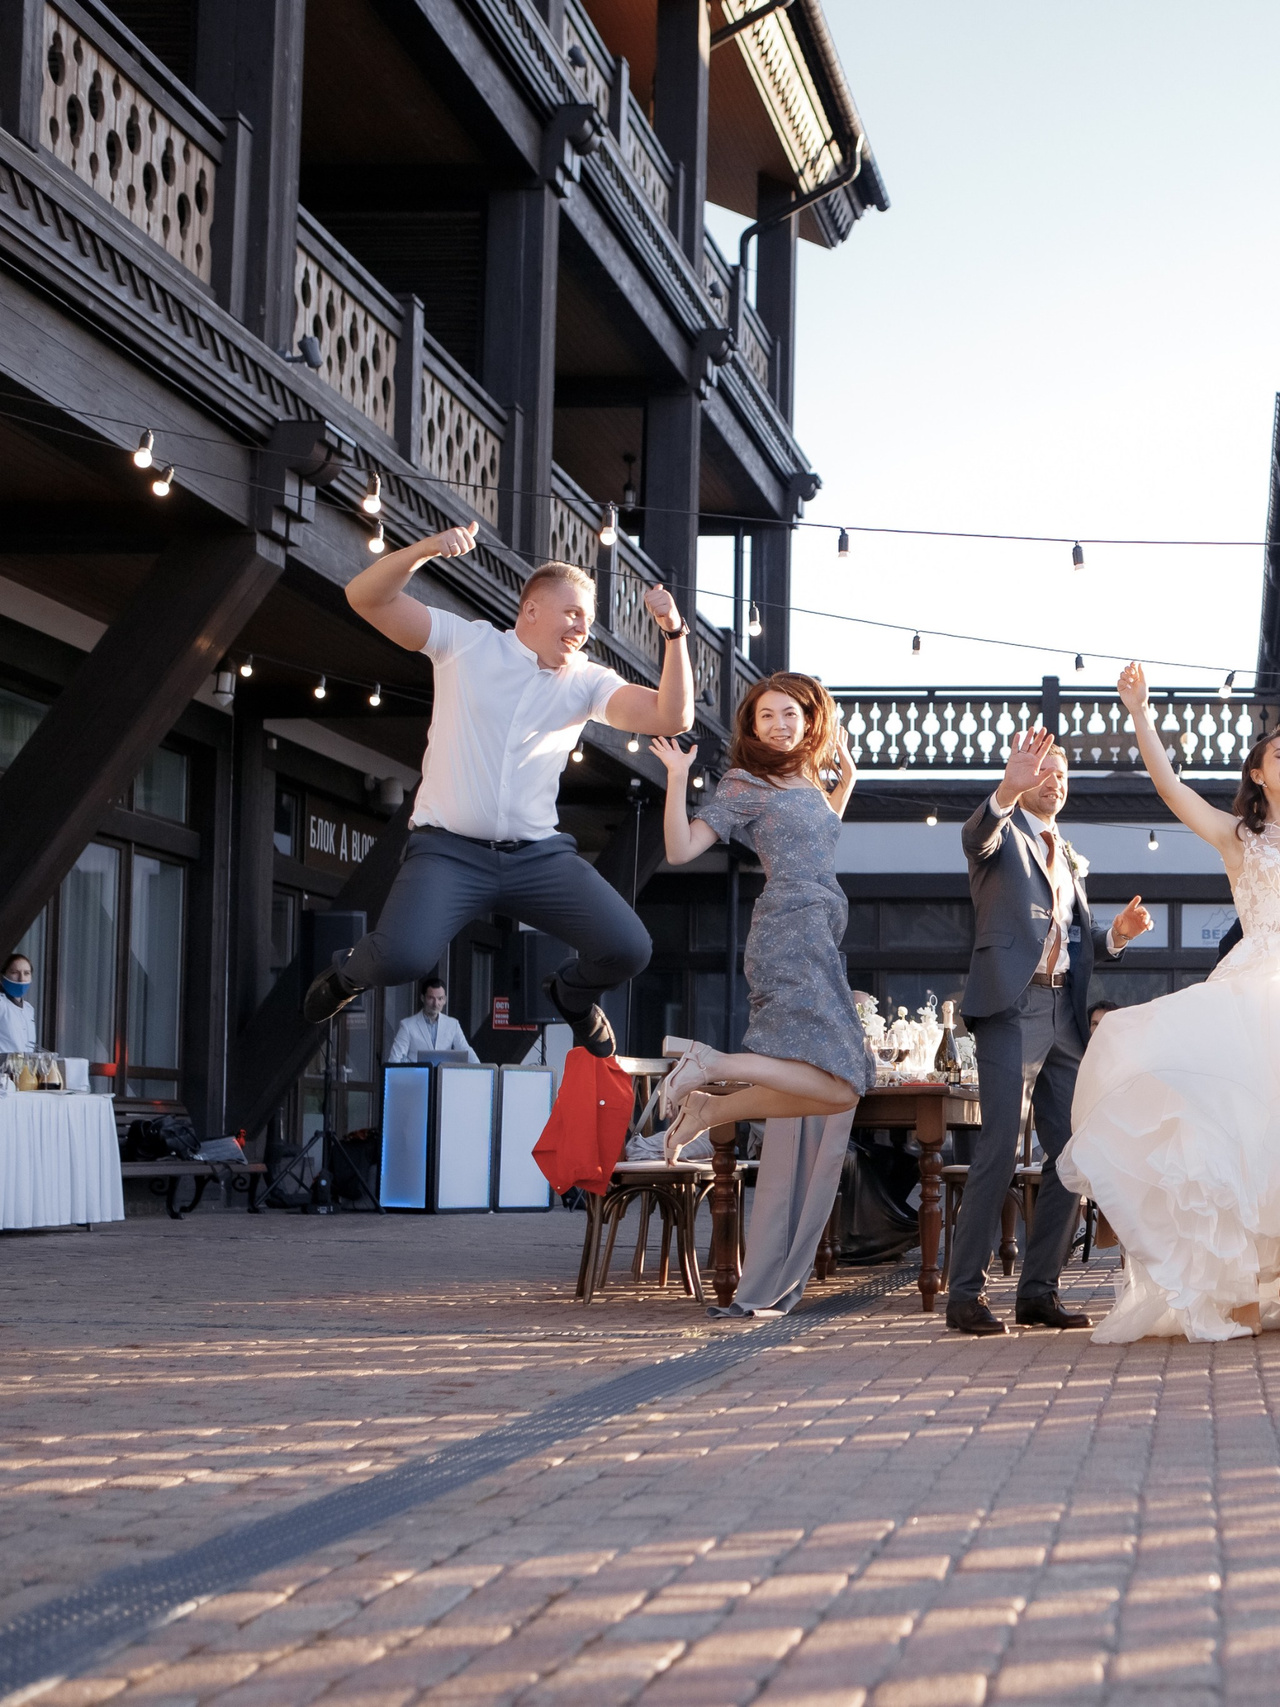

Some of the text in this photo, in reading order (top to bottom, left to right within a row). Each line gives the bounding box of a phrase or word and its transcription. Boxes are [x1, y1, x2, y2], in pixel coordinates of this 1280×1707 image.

[309, 814, 378, 863] БЛОК А BLO
